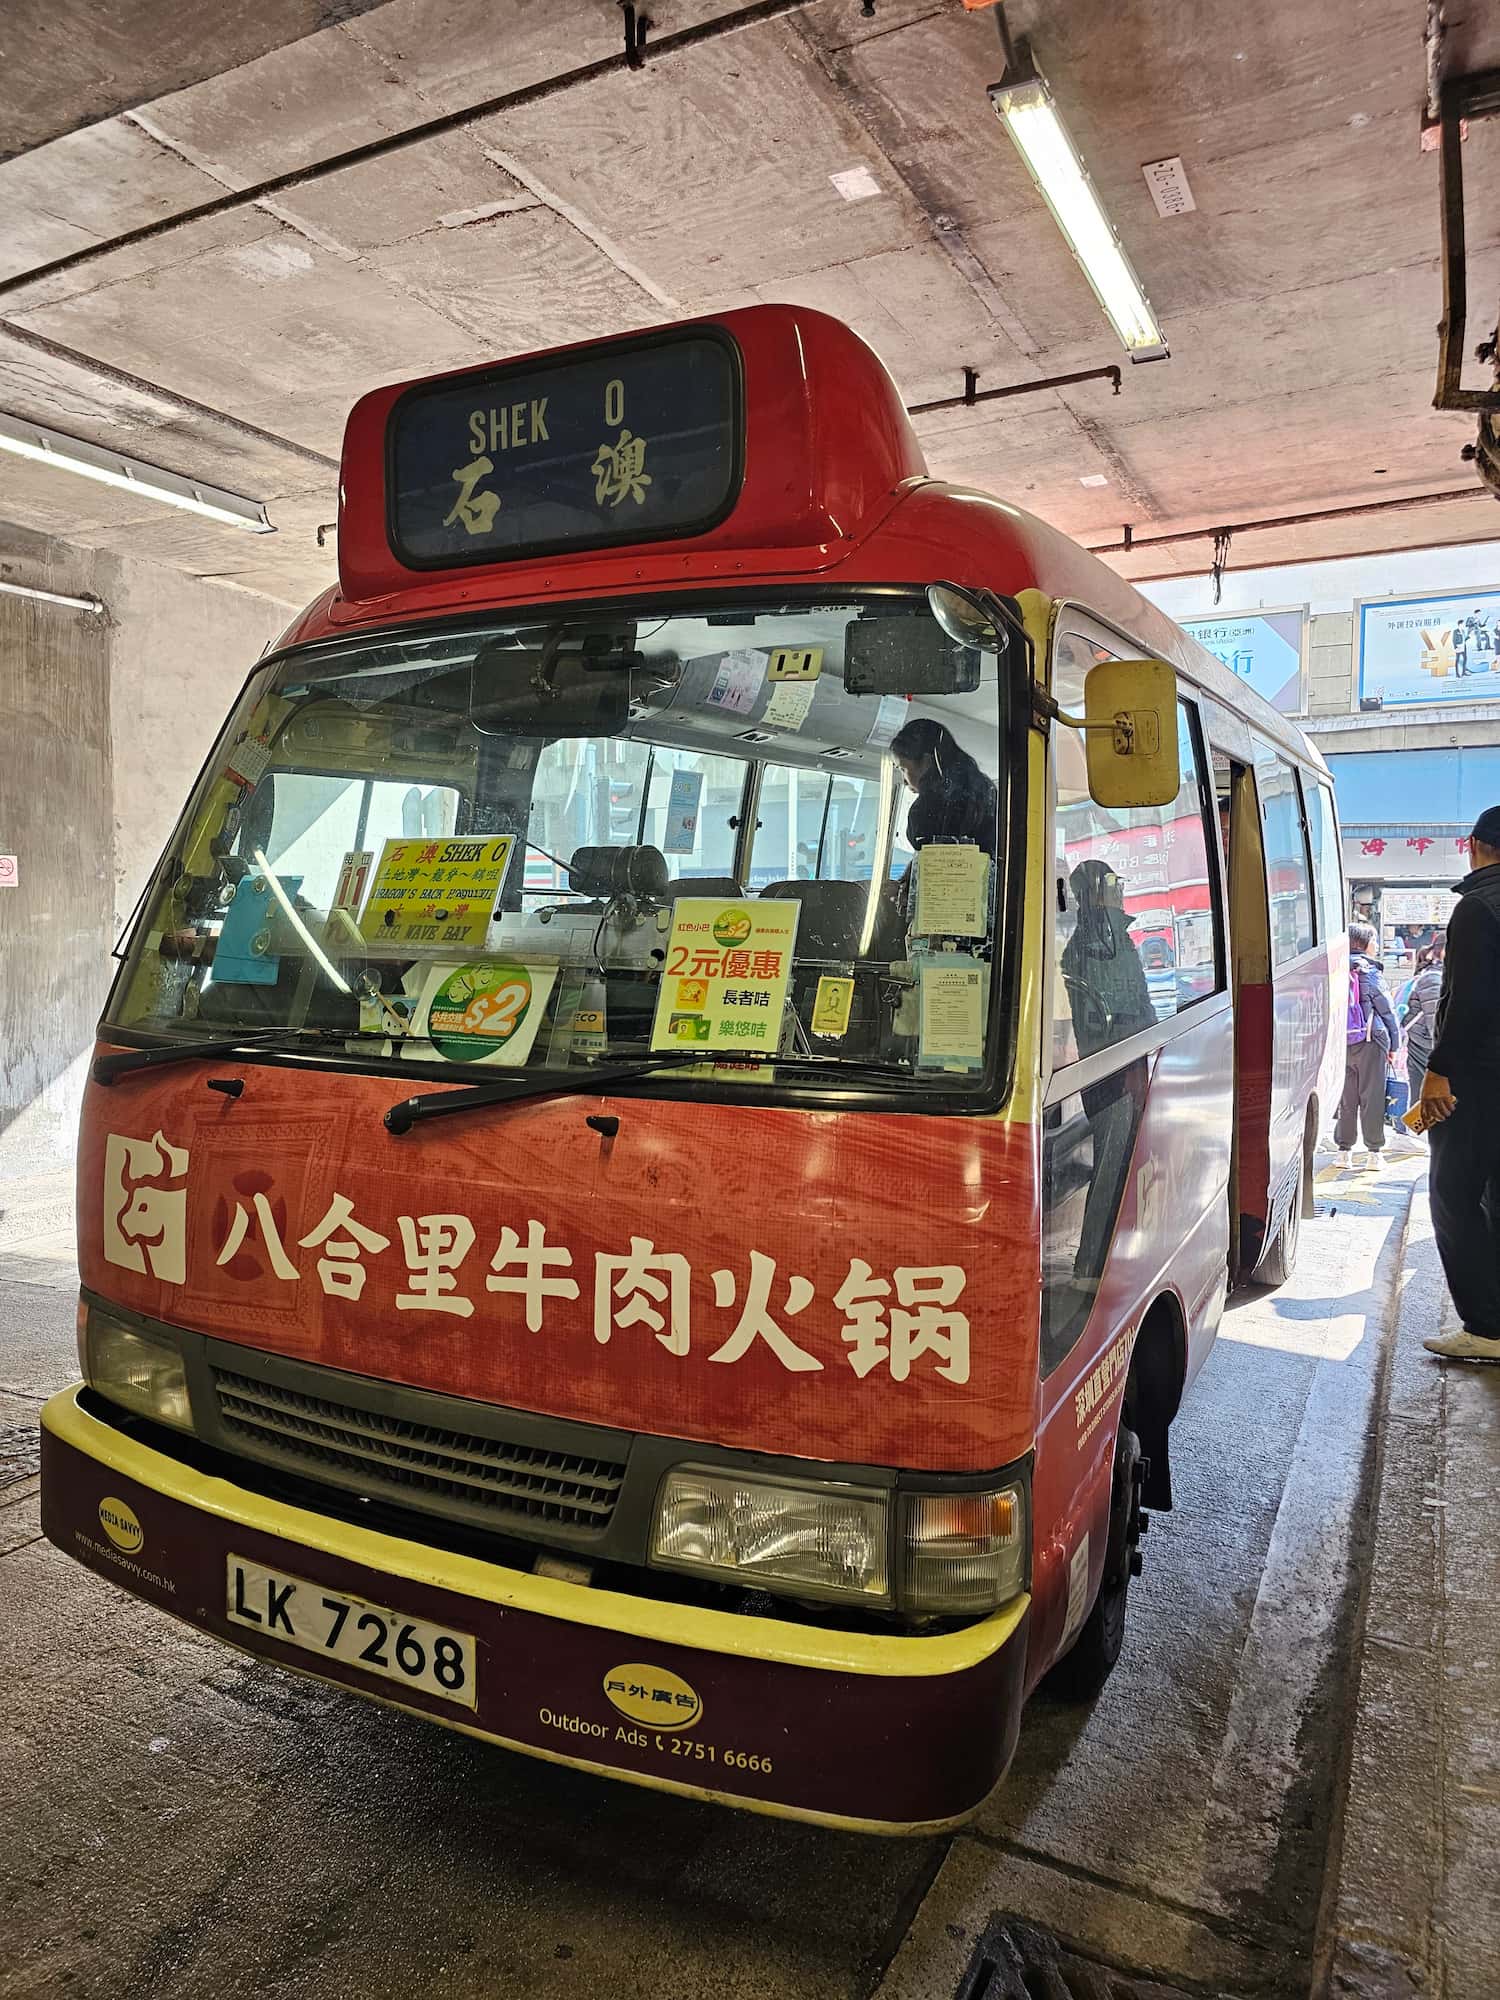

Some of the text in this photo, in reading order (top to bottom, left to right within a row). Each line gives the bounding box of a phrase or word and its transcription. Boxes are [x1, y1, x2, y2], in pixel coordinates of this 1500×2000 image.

[469, 398, 550, 455] SHEK
[438, 843, 488, 862] SHEK
[491, 842, 507, 861] O
[441, 926, 472, 941] BAY
[667, 946, 783, 980] 2元優惠
[465, 984, 527, 1032] $2
[722, 989, 771, 1007] 長者咭
[718, 1019, 768, 1039] 樂悠咭
[216, 1191, 970, 1385] 八合里牛肉火锅
[100, 1508, 141, 1538] MEDIA SAVVY
[73, 1528, 177, 1594] www.mediasavvy.com.hk
[235, 1567, 465, 1690] LK 7268
[606, 1680, 697, 1709] 戶外廣告
[539, 1707, 773, 1774] Outdoor Ads 2751 6666
